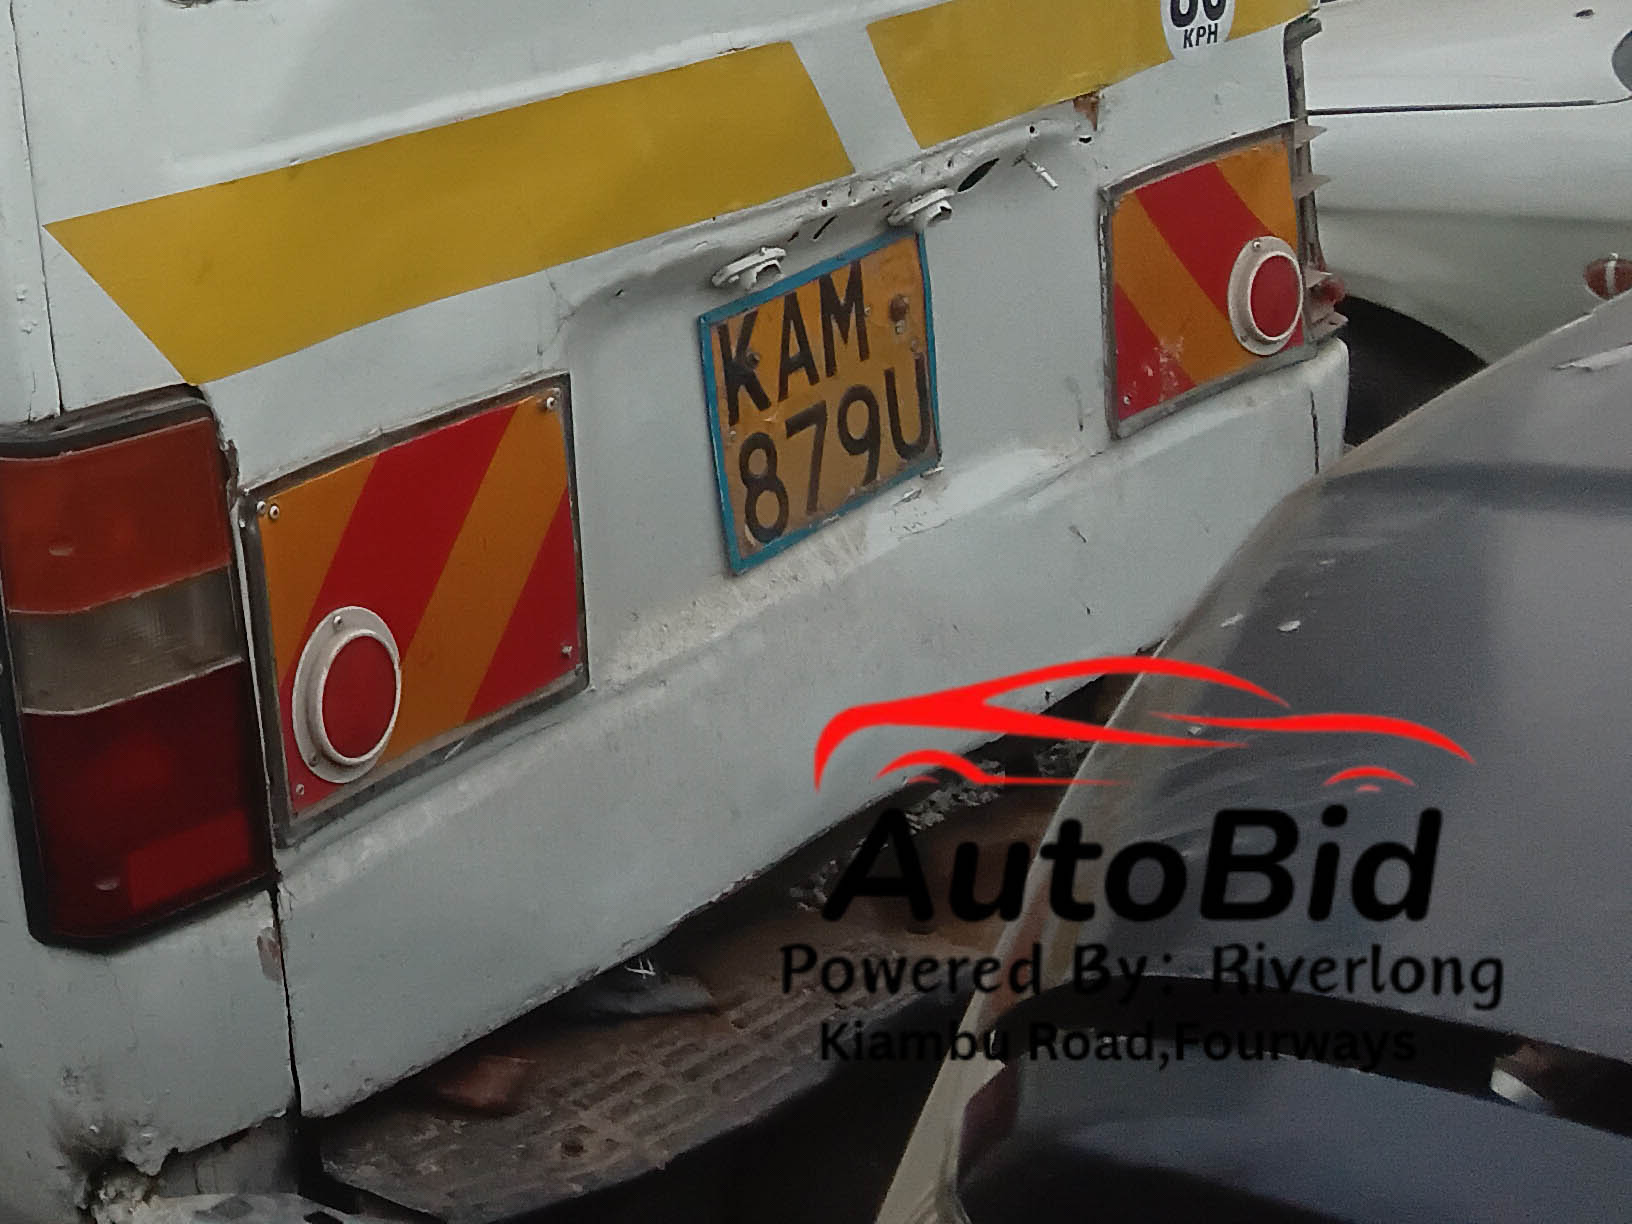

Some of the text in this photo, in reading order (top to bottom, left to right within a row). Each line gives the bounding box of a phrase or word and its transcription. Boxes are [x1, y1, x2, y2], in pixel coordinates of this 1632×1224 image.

[1183, 23, 1218, 49] KPH
[717, 259, 870, 427] KAM
[738, 352, 932, 544] 879U
